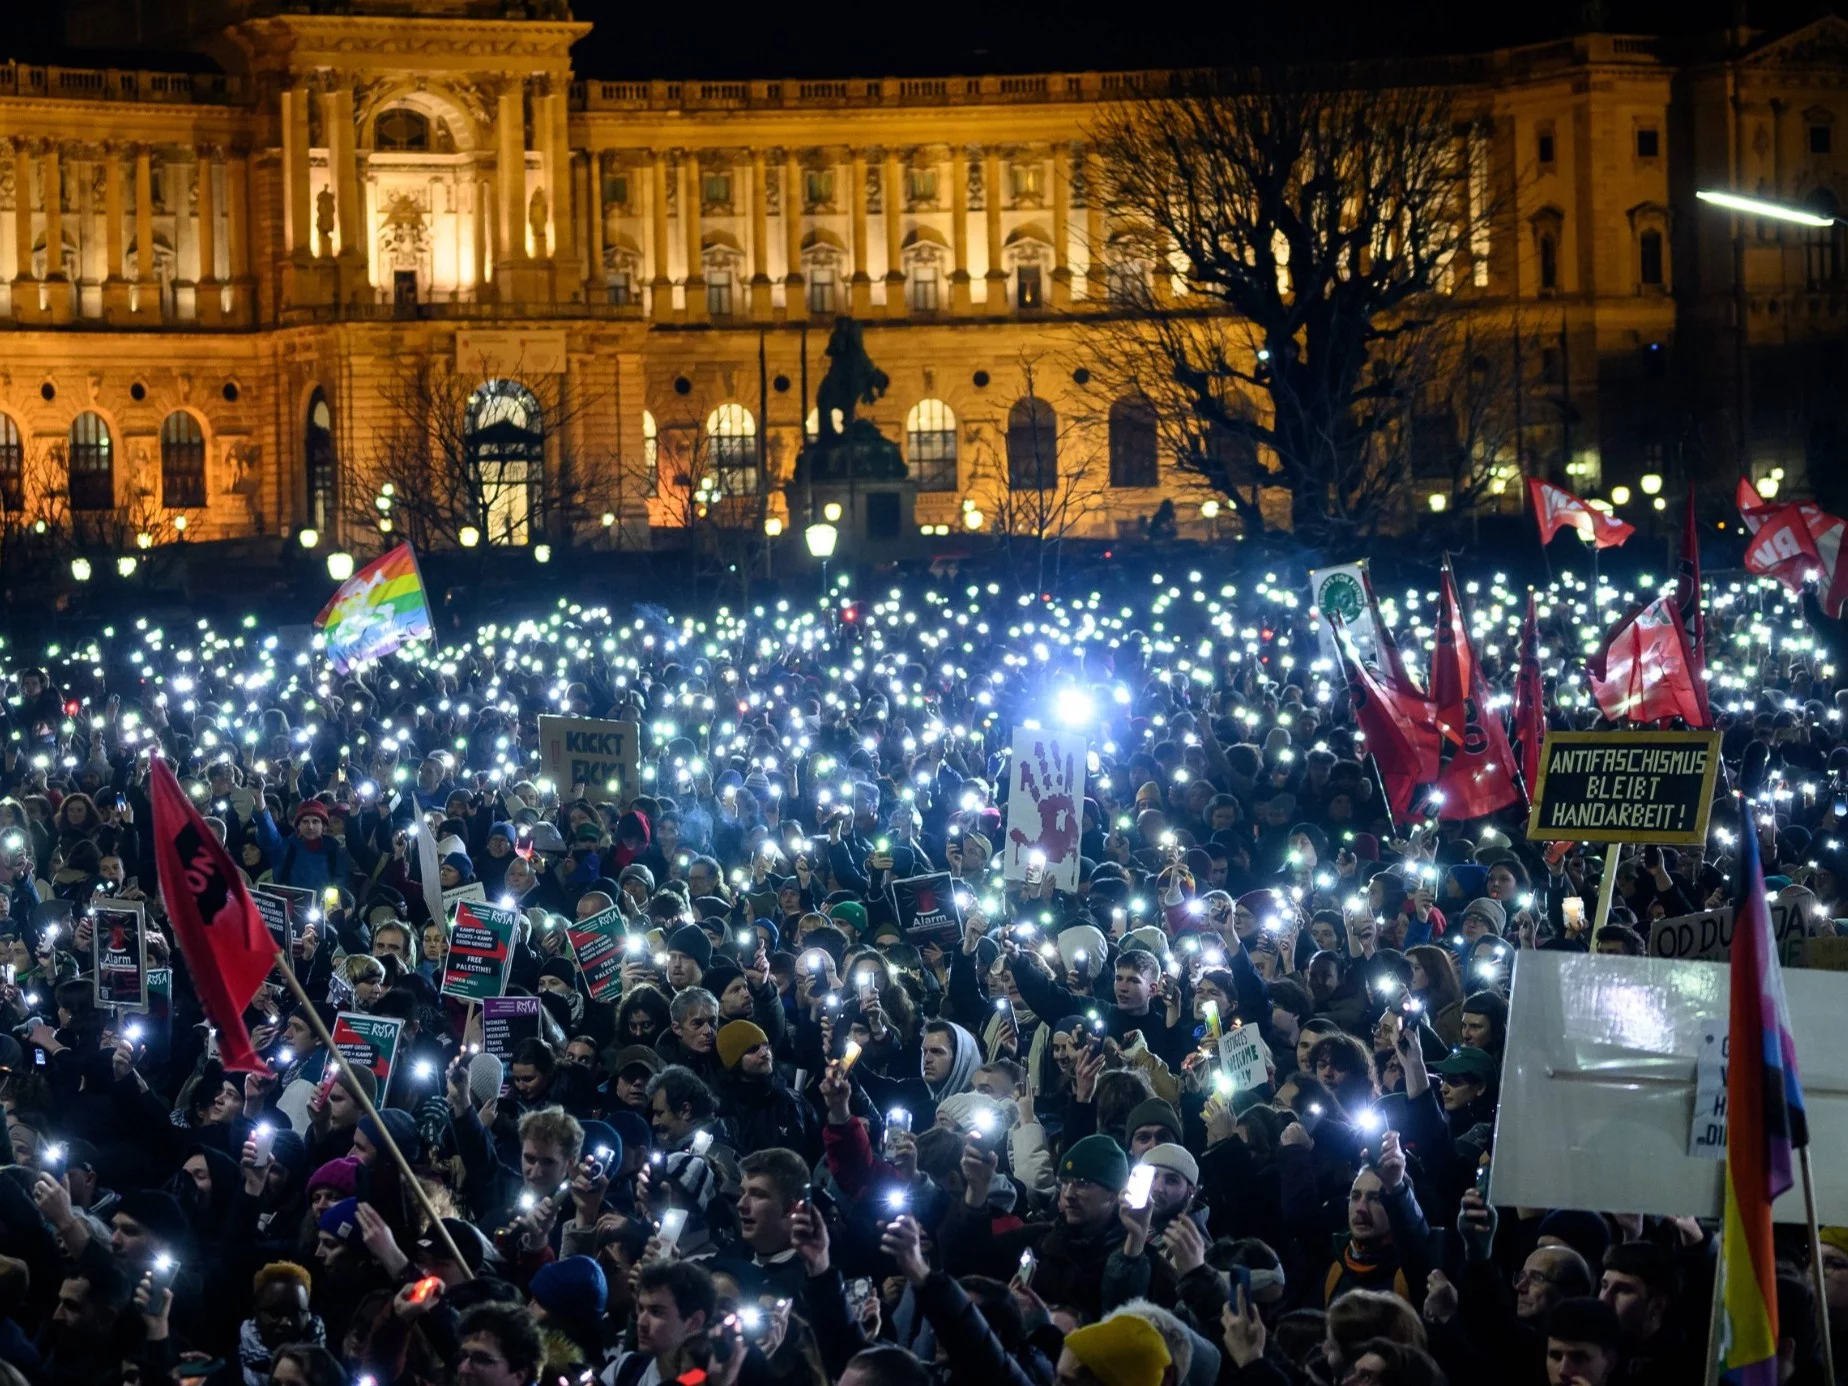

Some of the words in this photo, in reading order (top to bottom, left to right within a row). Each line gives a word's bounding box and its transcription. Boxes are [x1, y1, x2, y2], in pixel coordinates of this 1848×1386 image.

[566, 731, 624, 756] KICKT
[1550, 749, 1708, 774] ANTIFASCHISMUS
[1586, 775, 1661, 800] BLEIBT
[491, 910, 513, 925] ROSA
[598, 910, 619, 927] ROSA
[912, 914, 947, 927] Alarm
[459, 927, 475, 935] KAMPF
[475, 928, 491, 936] GEGEN
[1657, 924, 1694, 958] OD
[104, 953, 131, 964] Alarm
[467, 955, 483, 963] FREE
[600, 958, 615, 969] FREE
[456, 963, 491, 974] PALESTINE!
[594, 963, 621, 980] PALESTIN
[516, 1000, 538, 1014] ROSA
[371, 1023, 395, 1039] ROSA
